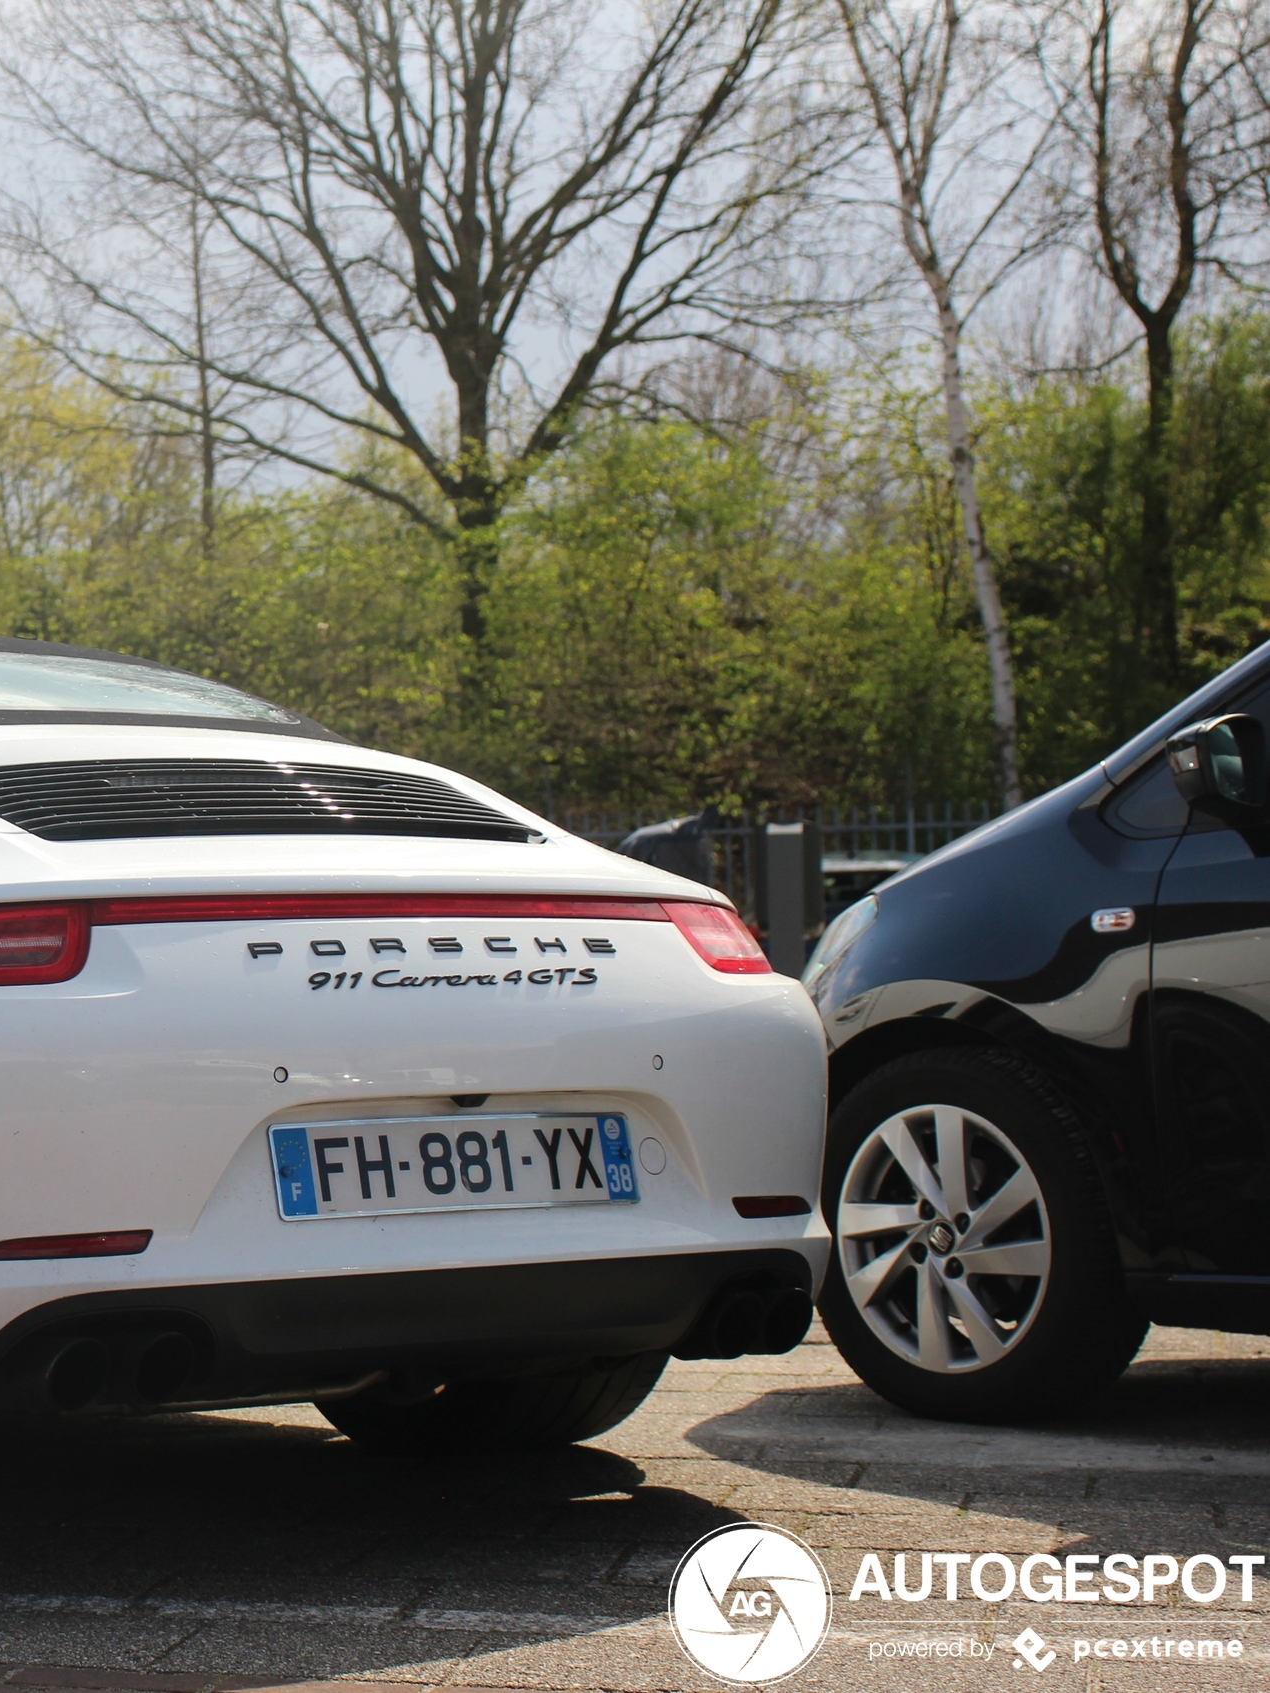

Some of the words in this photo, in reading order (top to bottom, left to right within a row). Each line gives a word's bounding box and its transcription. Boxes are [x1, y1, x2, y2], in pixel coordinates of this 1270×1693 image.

[247, 936, 617, 959] PORSCHE
[308, 970, 363, 990] 911
[371, 969, 499, 988] Carrera
[527, 967, 598, 985] GTS
[313, 1127, 604, 1202] FH-881-YX
[607, 1163, 633, 1193] 38
[291, 1182, 302, 1201] F
